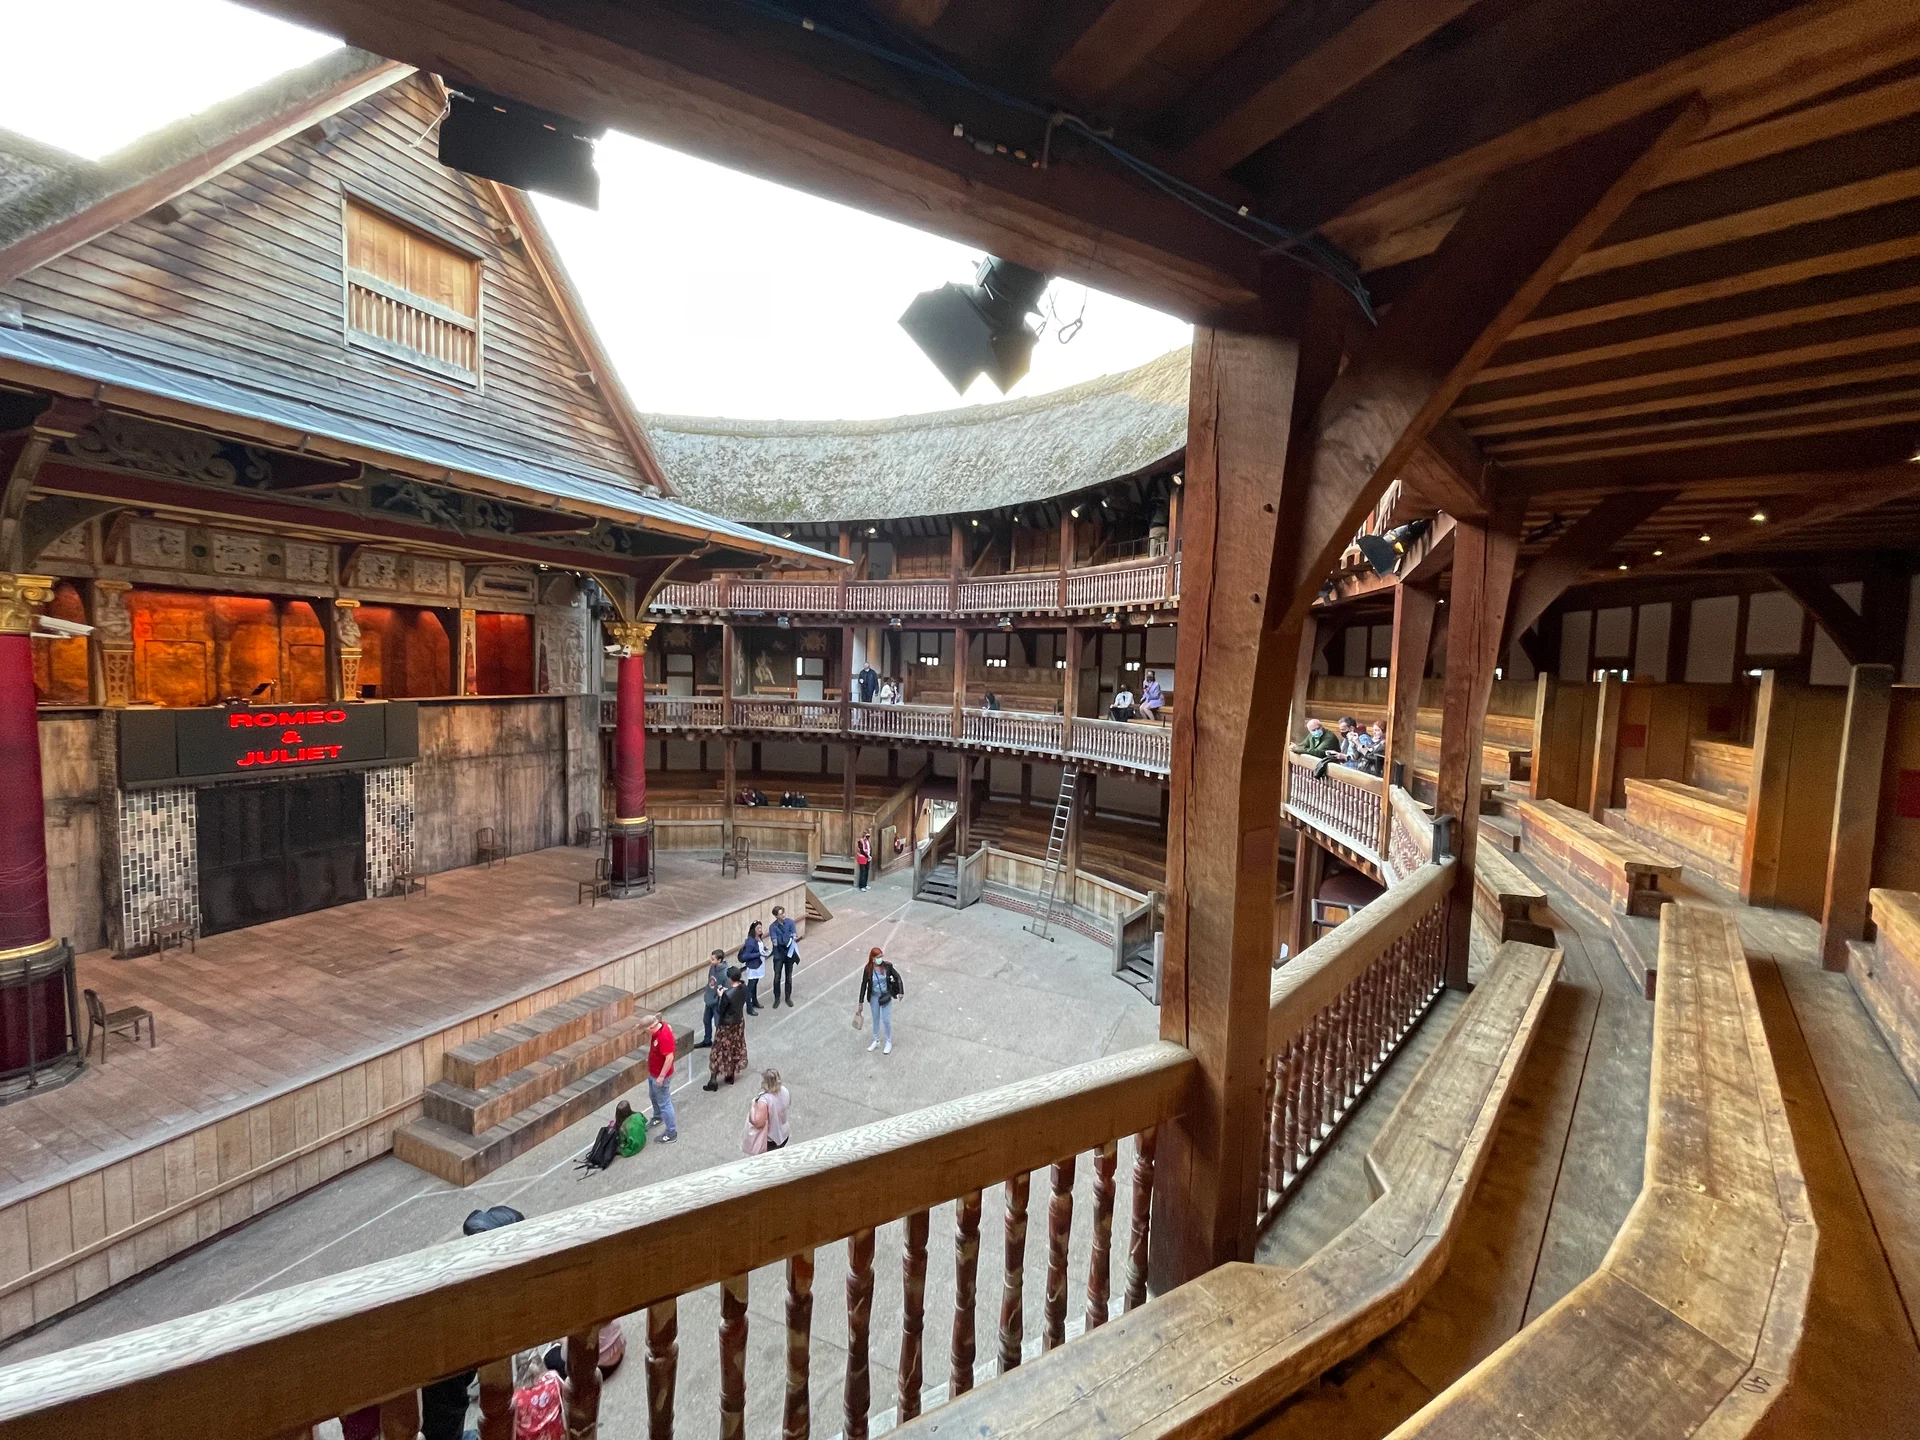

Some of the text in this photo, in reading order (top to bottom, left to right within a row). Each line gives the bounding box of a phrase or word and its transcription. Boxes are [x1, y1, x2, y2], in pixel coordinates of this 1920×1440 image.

[229, 709, 347, 728] ROMEO
[281, 730, 303, 744] &
[236, 745, 343, 766] JULIET
